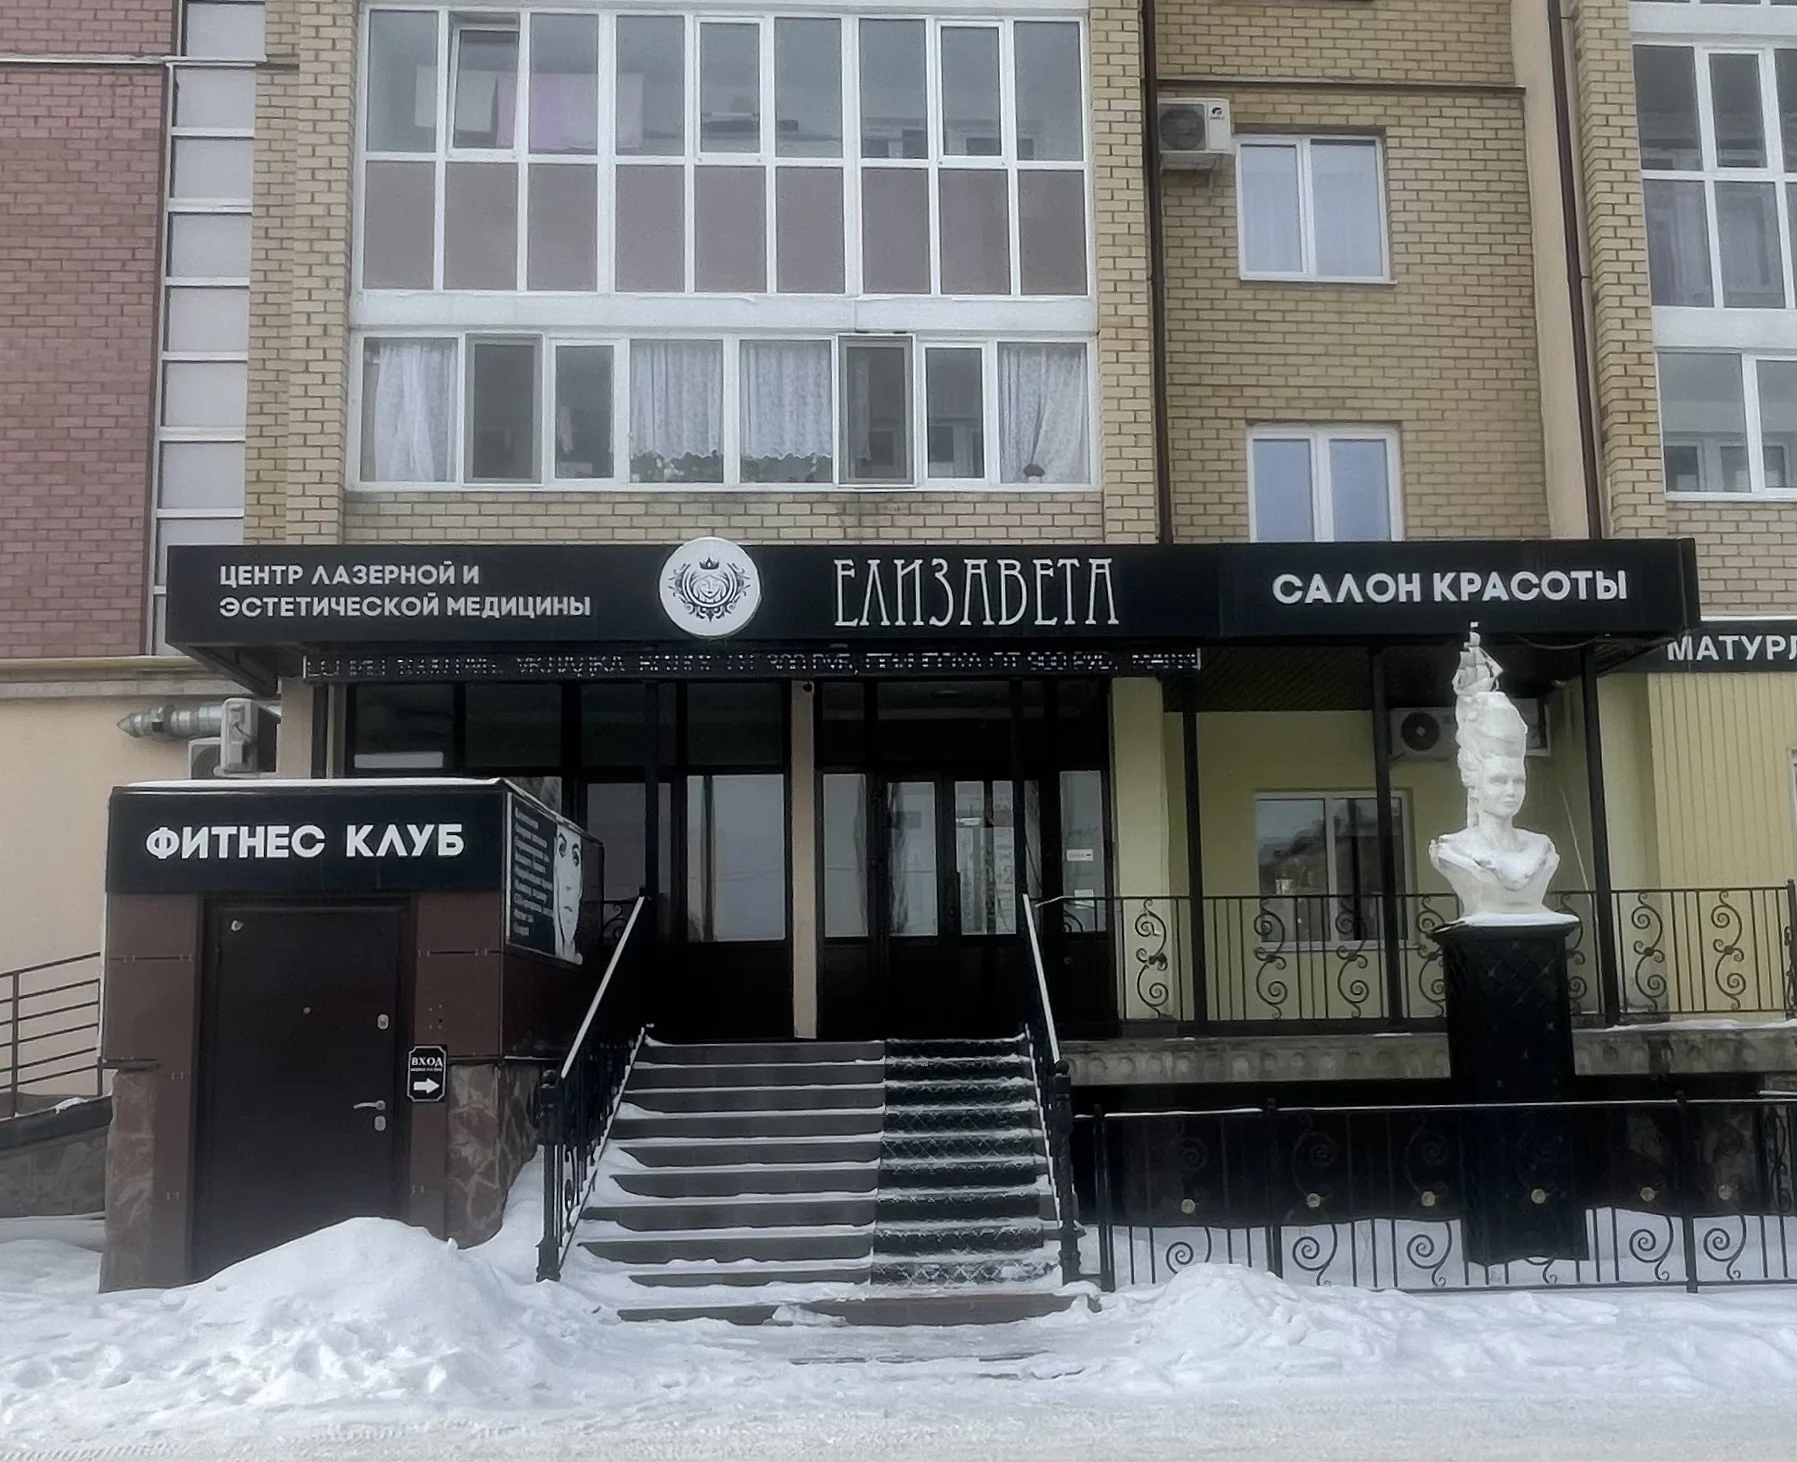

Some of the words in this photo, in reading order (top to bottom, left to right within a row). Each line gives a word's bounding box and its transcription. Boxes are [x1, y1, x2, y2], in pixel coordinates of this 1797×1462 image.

[219, 565, 304, 588] ЦЕНТР
[310, 561, 456, 585] ЛАЗЕРНОЙ
[462, 565, 481, 585] И
[1272, 572, 1421, 605] САЛОН
[1432, 569, 1628, 603] КРАСОТЫ
[218, 593, 440, 618] ЭСТЕТИЧЕСКОЙ
[446, 596, 592, 619] МЕДИЦИНЫ
[833, 558, 1120, 628] ЕЛИЗАВЕТА
[145, 824, 326, 860] ФИТНЕС
[346, 823, 465, 858] КЛУБ
[411, 1056, 443, 1067] ВХОД
